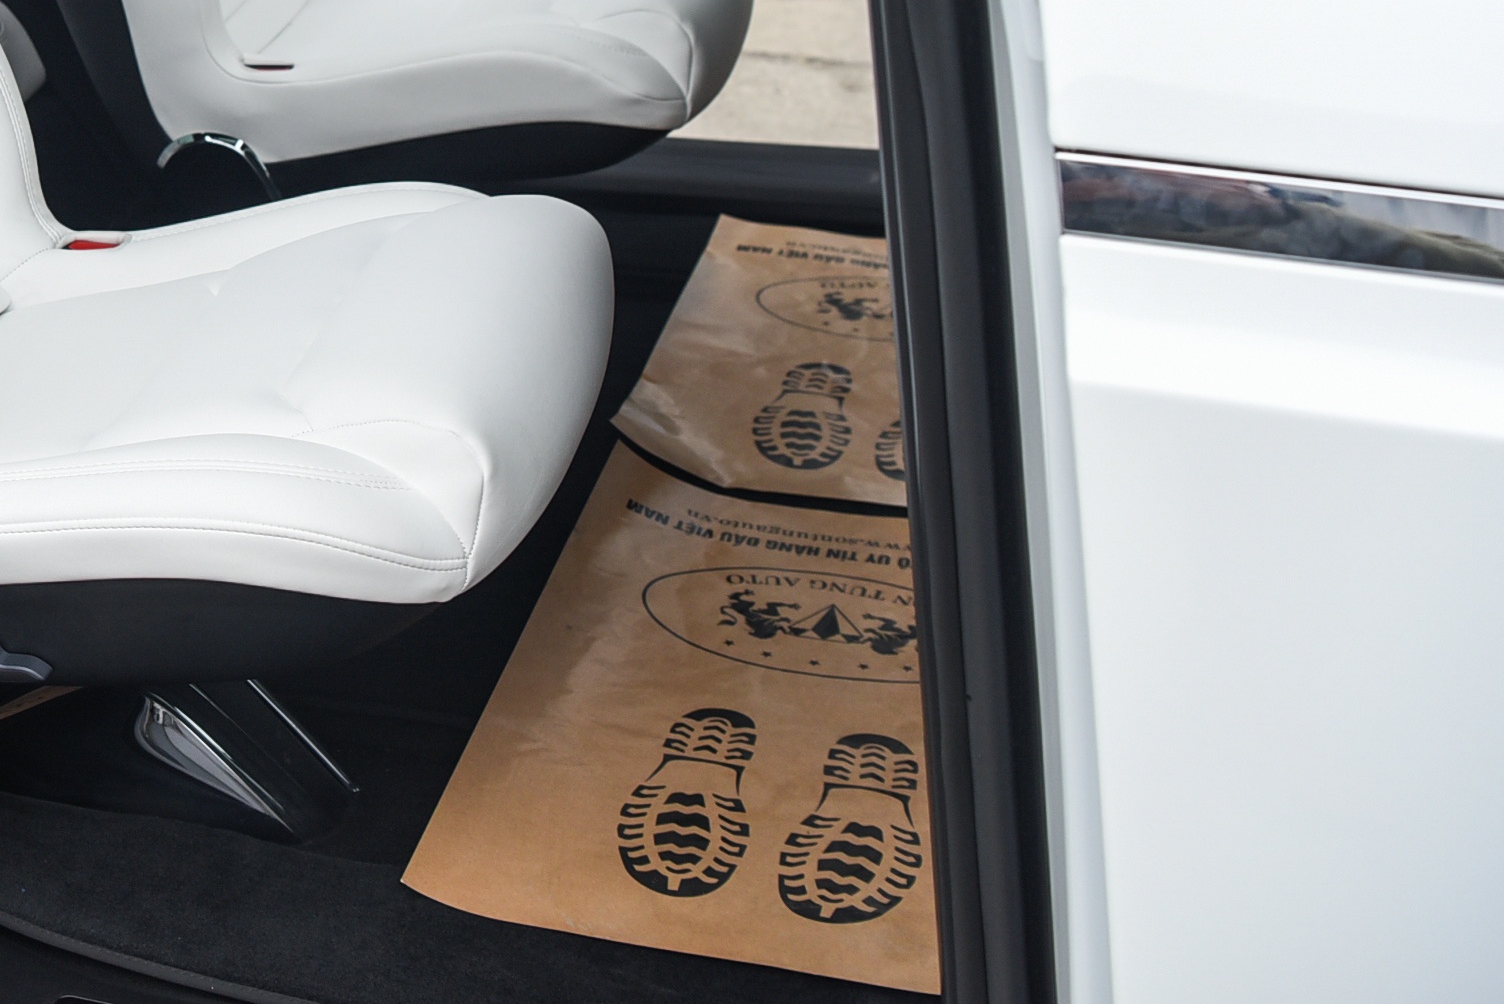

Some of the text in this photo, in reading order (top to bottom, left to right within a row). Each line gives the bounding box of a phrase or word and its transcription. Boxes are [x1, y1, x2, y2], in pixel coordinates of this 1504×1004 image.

[626, 498, 670, 526] NAM
[865, 553, 891, 566] UY
[725, 573, 801, 587] AUTO
[809, 579, 886, 602] TUNG
